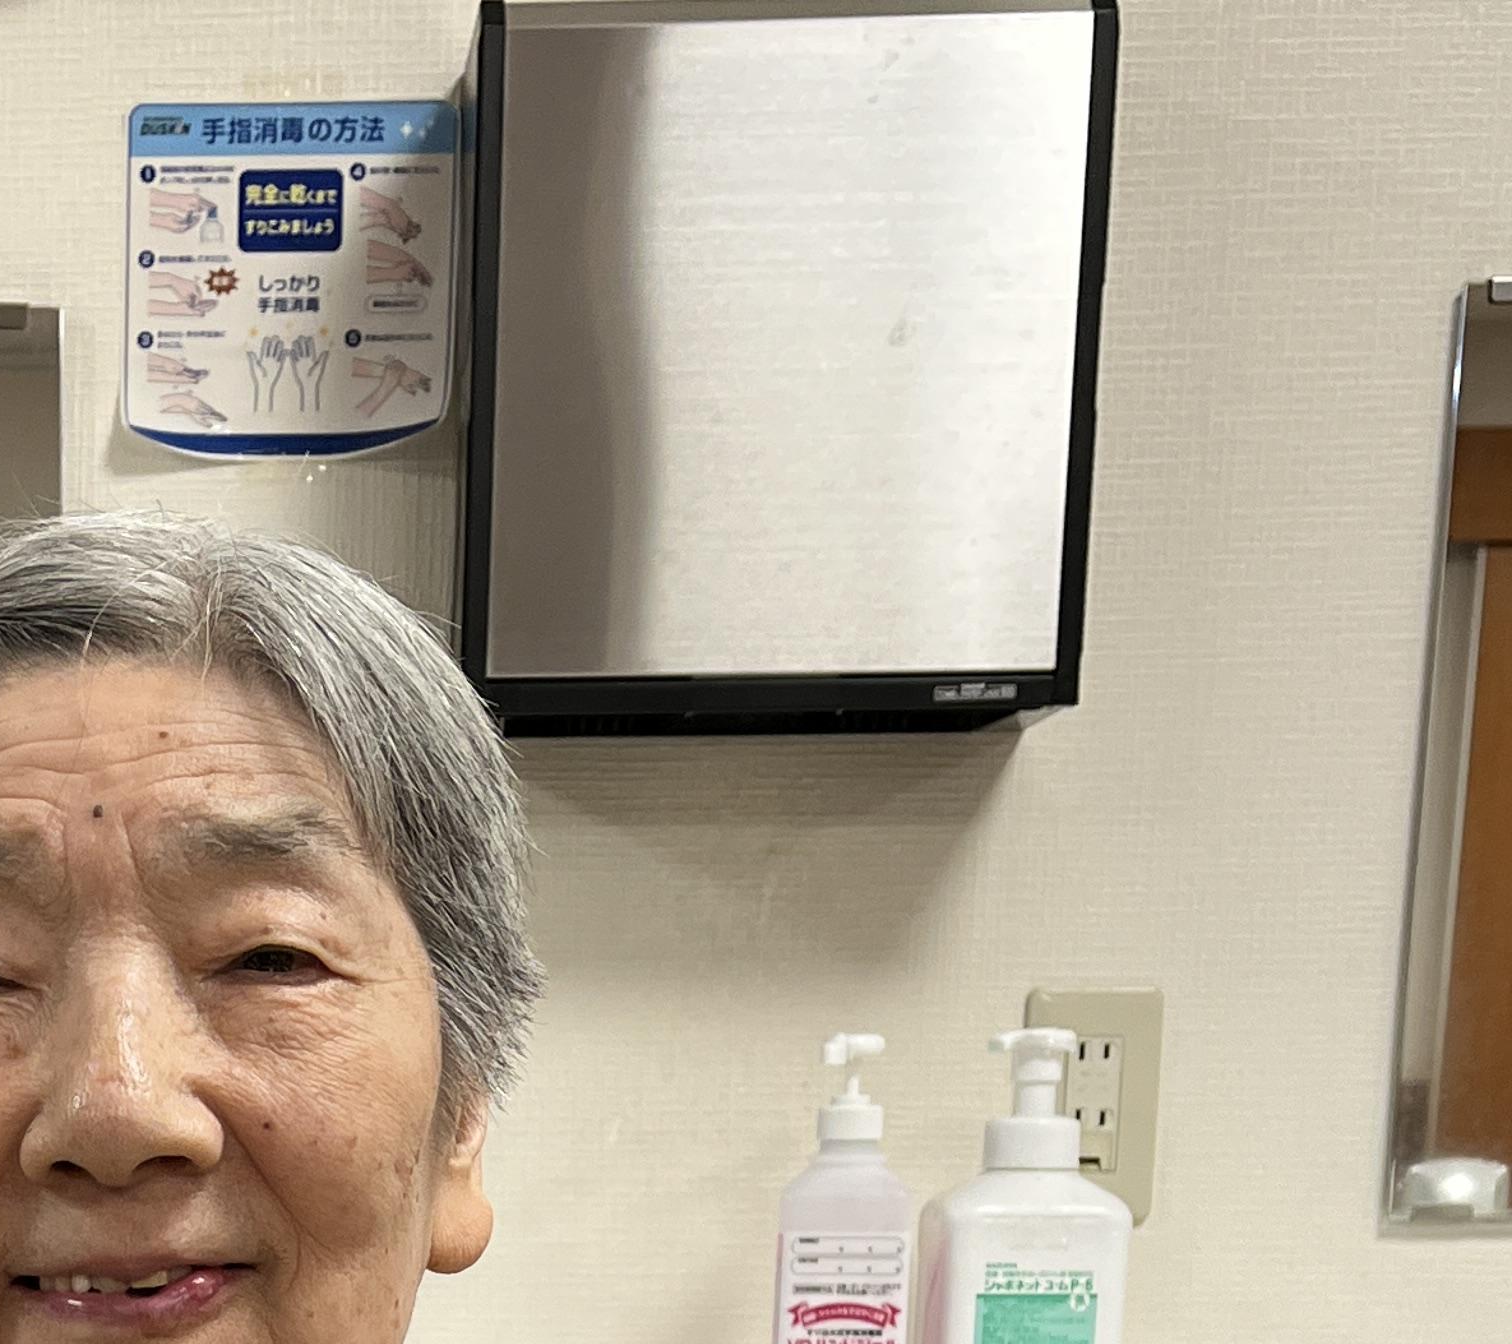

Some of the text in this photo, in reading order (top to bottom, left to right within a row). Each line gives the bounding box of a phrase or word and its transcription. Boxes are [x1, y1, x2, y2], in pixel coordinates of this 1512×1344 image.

[201, 116, 386, 145] 手指消毒の方法
[258, 274, 321, 293] しっかり
[257, 296, 321, 314] 手指消毒
